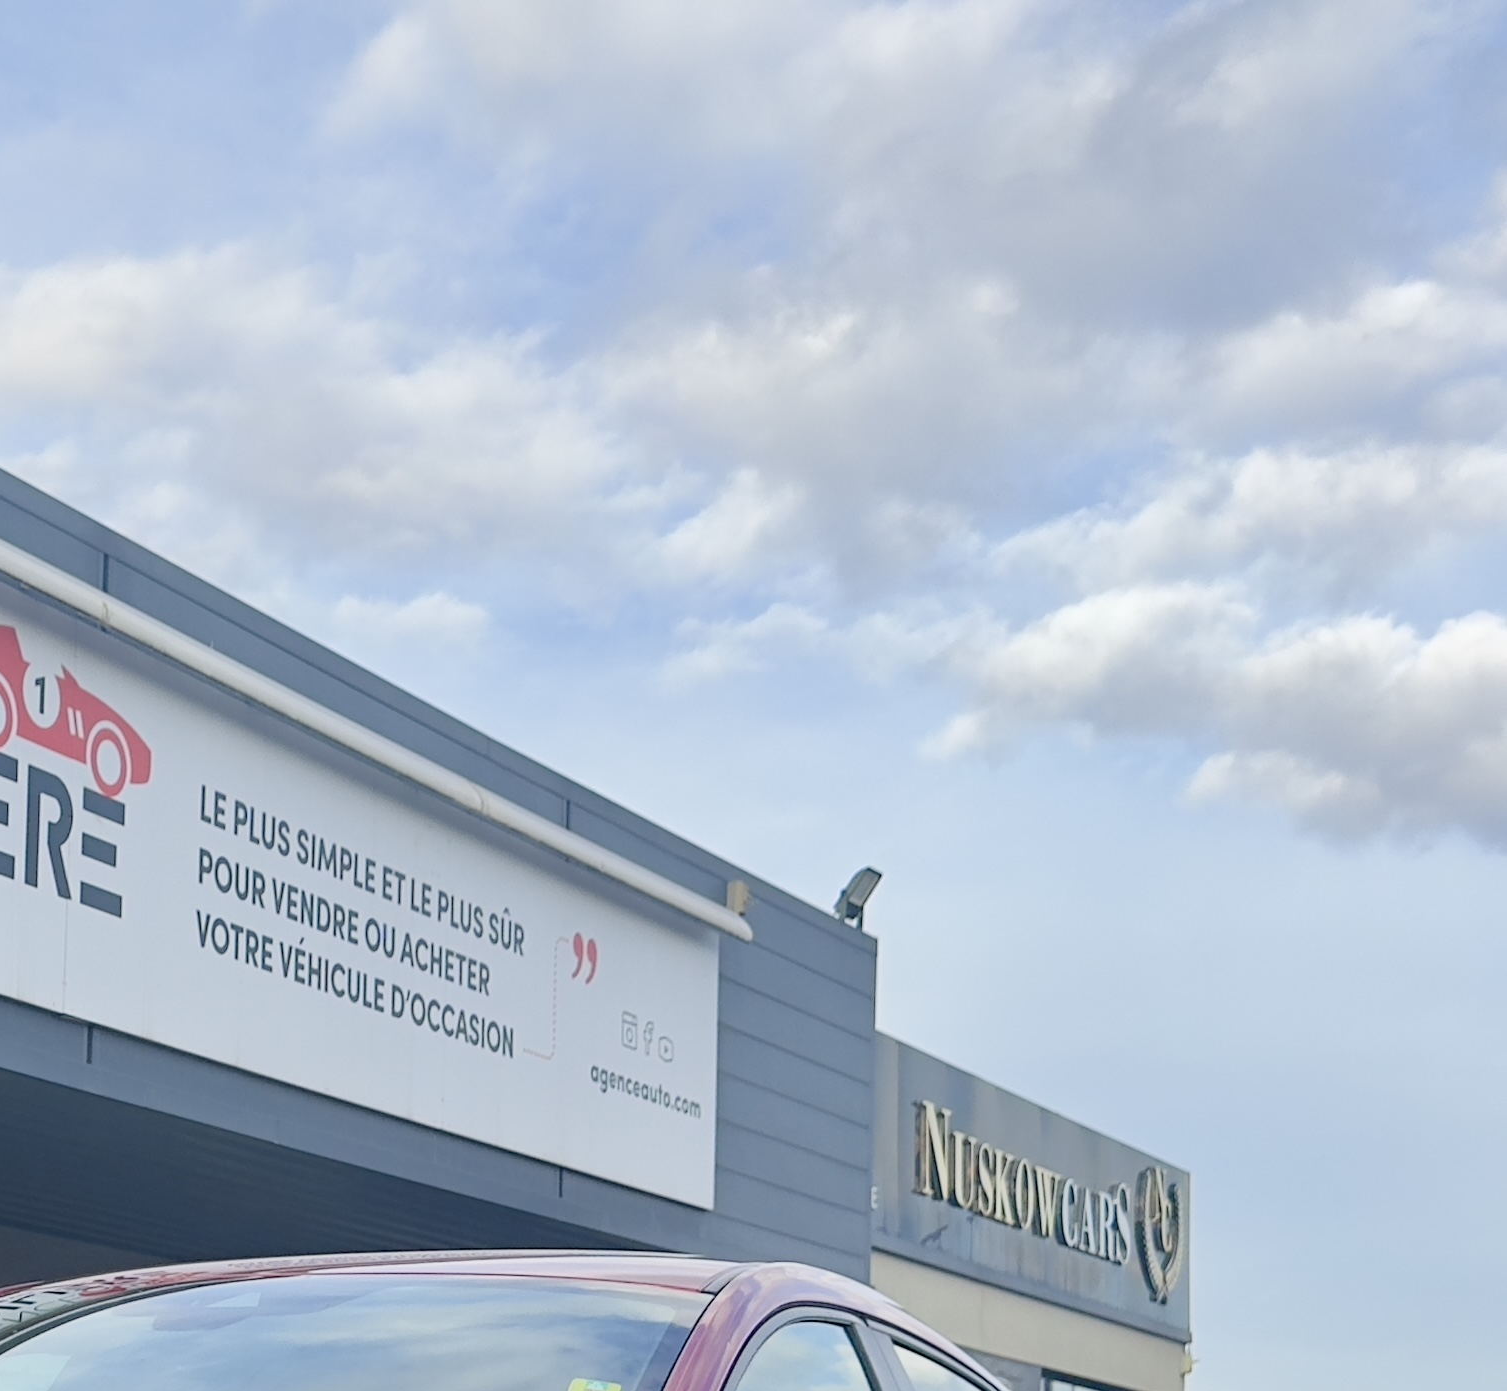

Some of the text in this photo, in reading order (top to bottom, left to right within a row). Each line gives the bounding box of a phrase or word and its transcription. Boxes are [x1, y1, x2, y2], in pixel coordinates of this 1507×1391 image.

[198, 847, 491, 998] POUR VENDRE OU ACHETER
[200, 785, 525, 957] LE PLUS SIMPLE ET LE PLUS SÛR
[196, 909, 515, 1059] VOTRE VÉHICULE D'OCCASION
[590, 1065, 701, 1119] agenceauto.com
